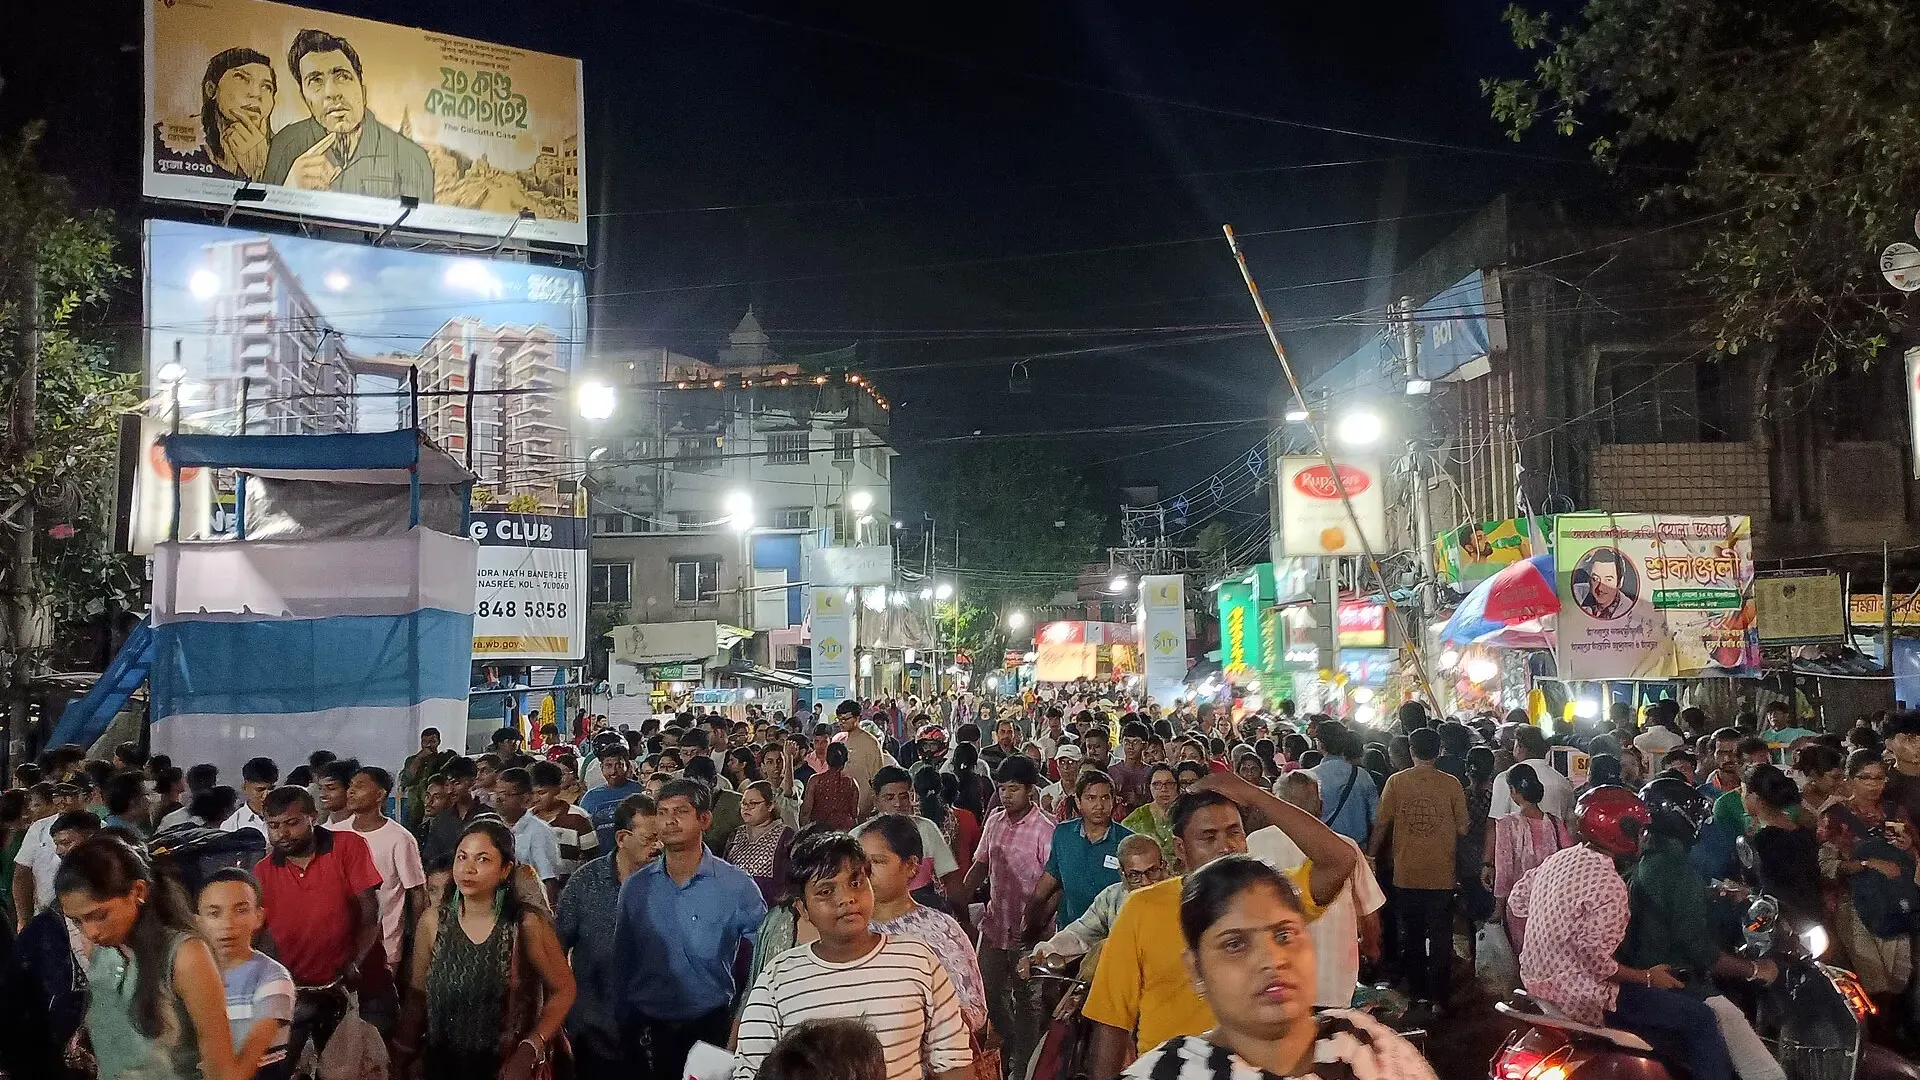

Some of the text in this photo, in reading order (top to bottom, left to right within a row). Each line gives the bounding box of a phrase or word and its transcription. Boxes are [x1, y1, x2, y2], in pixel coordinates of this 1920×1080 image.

[460, 125, 494, 137] Calcutta
[496, 131, 517, 140] Case
[502, 569, 525, 578] NATH
[527, 570, 568, 579] BANERJEE
[519, 580, 534, 589] KOL
[524, 601, 567, 618] 5858
[662, 667, 682, 677] Sprite
